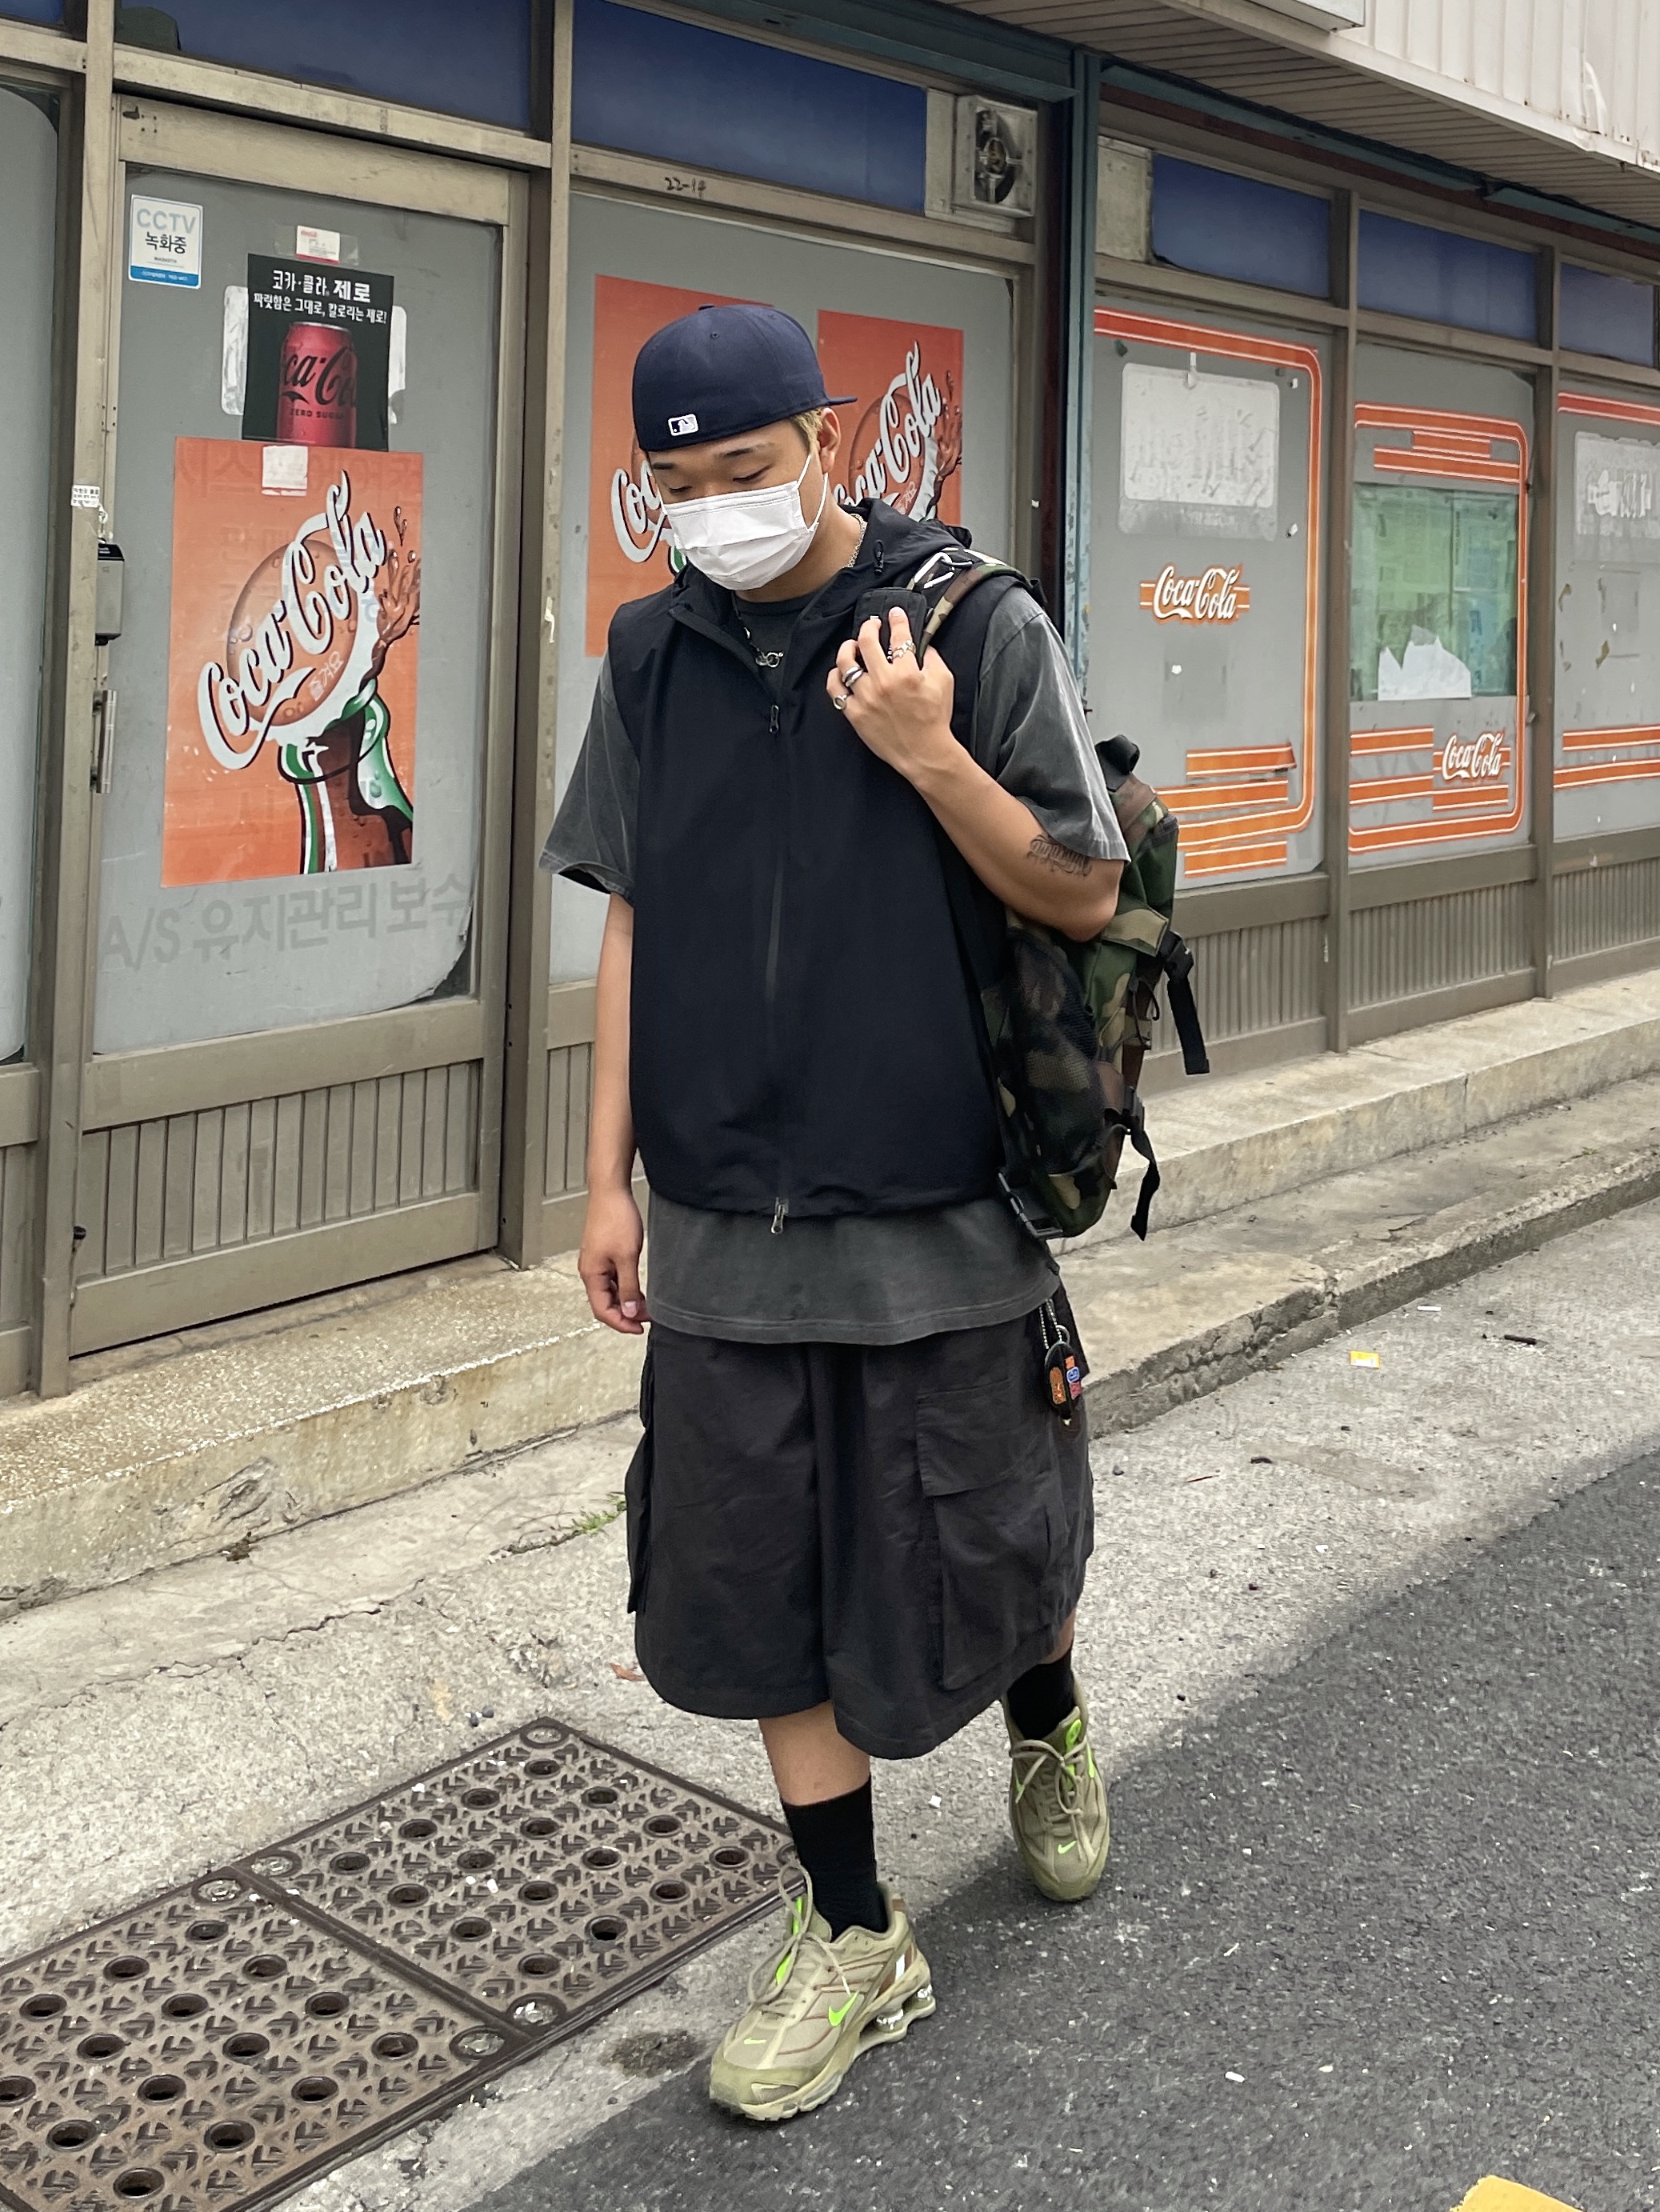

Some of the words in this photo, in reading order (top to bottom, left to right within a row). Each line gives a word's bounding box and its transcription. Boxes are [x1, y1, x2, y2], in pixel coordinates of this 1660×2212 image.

[137, 208, 196, 234] CCTV
[145, 231, 186, 254] 녹화중
[333, 279, 370, 303] 제로
[254, 293, 292, 312] 짜릿함은
[328, 302, 364, 322] 칼로리는
[366, 308, 387, 324] 제로!
[1154, 566, 1240, 619] Coca-Cola
[1442, 733, 1503, 780] Coca-Cola
[102, 907, 180, 971] A/S
[193, 882, 377, 964] 유지관리
[387, 874, 466, 934] 보수
